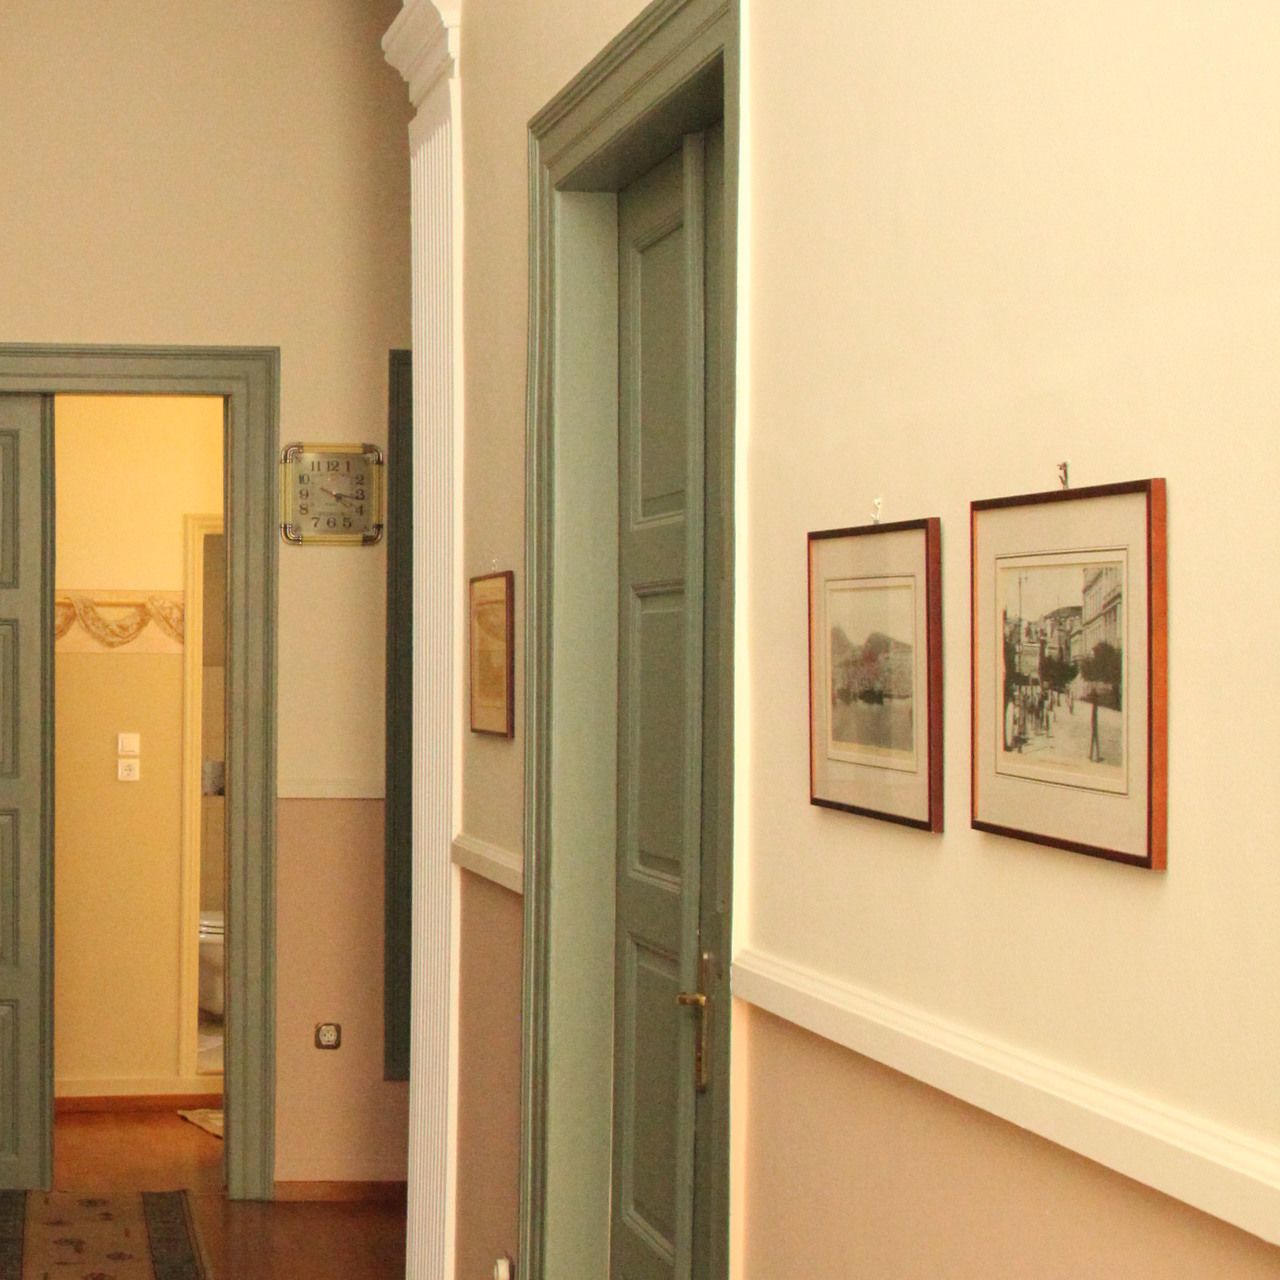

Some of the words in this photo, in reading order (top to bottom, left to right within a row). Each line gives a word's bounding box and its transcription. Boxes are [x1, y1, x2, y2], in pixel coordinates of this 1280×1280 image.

[311, 460, 321, 472] 11
[327, 460, 340, 472] 12
[346, 460, 351, 472] 1
[299, 474, 310, 485] 10
[355, 474, 365, 486] 2
[299, 488, 309, 499] 9
[355, 488, 366, 500] 3
[299, 504, 309, 515] 8
[355, 504, 364, 516] 4
[311, 516, 320, 528] 7
[326, 517, 337, 528] 6
[342, 517, 352, 528] 5
